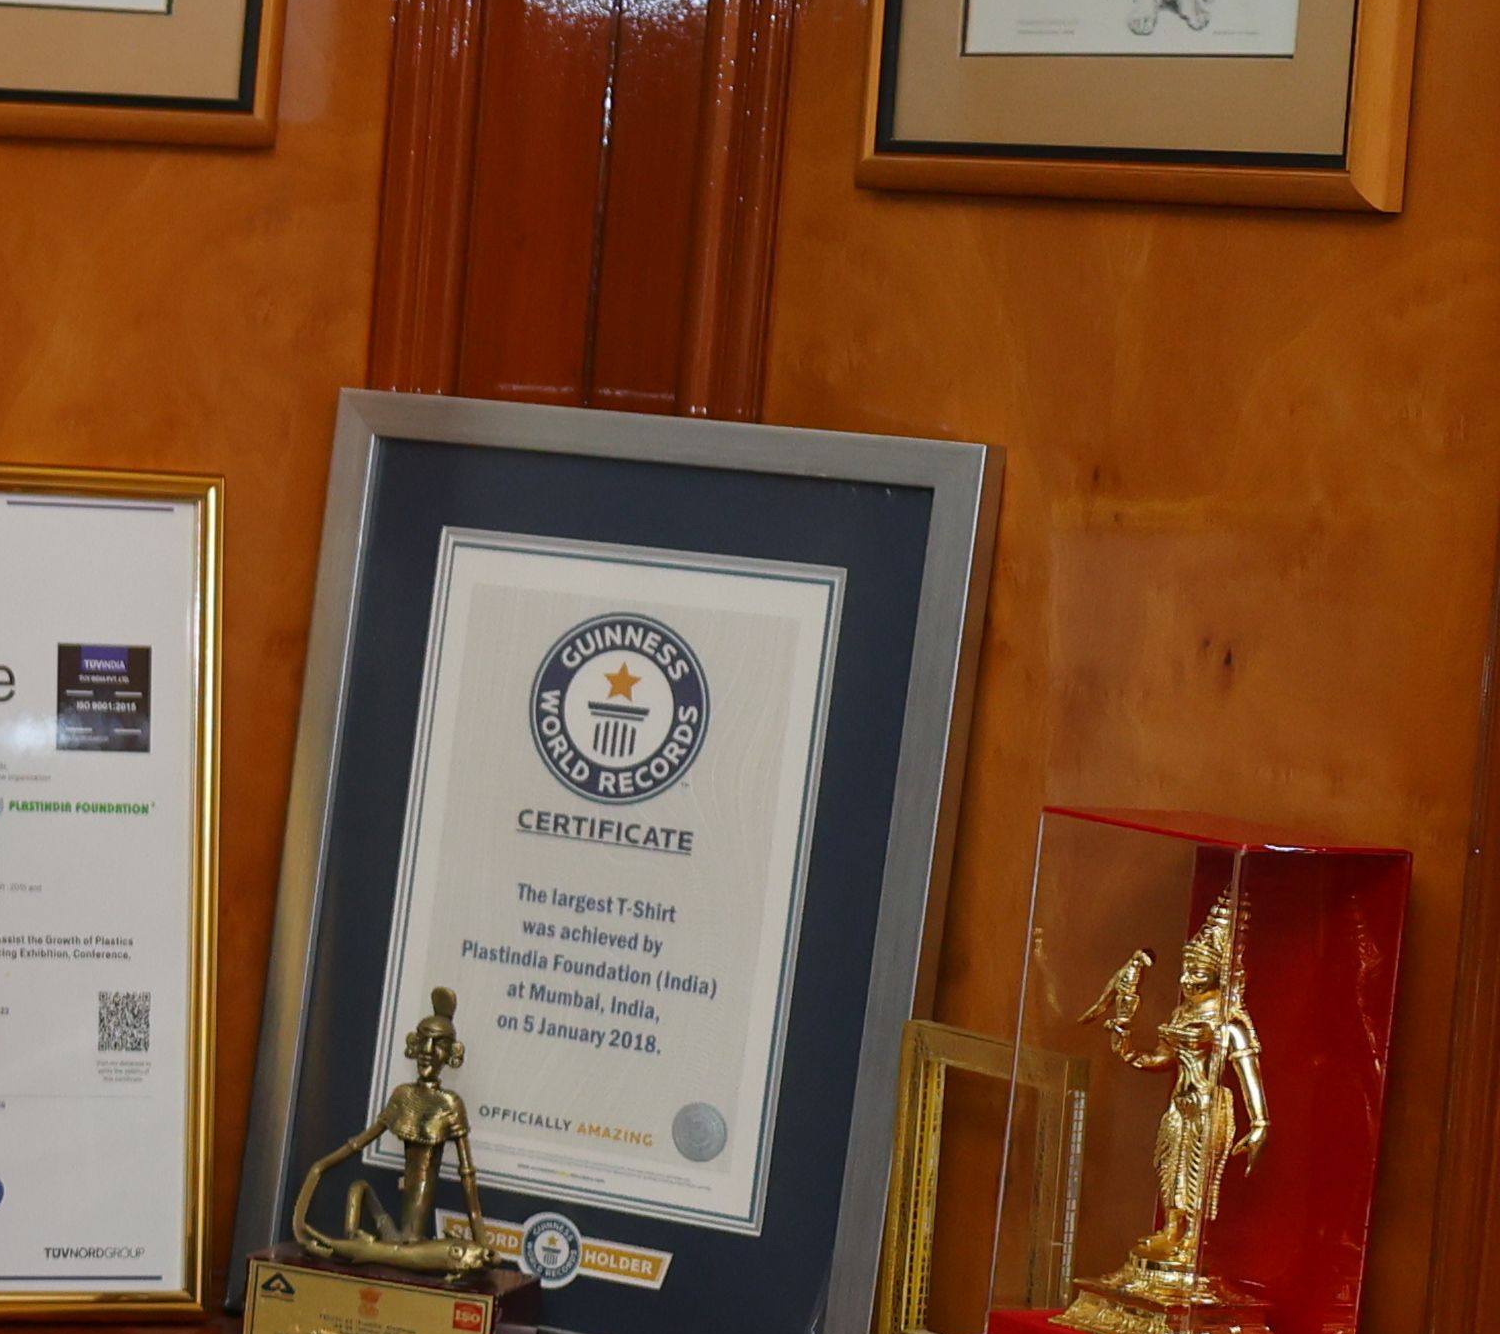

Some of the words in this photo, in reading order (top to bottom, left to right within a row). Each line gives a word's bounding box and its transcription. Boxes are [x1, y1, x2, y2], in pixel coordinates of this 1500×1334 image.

[562, 624, 690, 681] GUINNESS
[541, 689, 590, 782] WORLD
[598, 705, 698, 793] RECORDS
[9, 800, 71, 812] PLASTINDIA
[75, 802, 149, 815] FOUNDATION
[517, 809, 694, 851] CERTIFICATE
[517, 883, 548, 904] The
[552, 888, 613, 914] largest
[617, 898, 677, 923] T-Shirt
[27, 935, 43, 944] the
[45, 935, 81, 945] Growth
[83, 935, 93, 945] of
[95, 936, 134, 946] Plastics
[522, 921, 556, 938] was
[560, 925, 638, 951] achieved
[643, 935, 663, 958] by
[461, 939, 548, 969] Plastindia
[552, 954, 651, 987] Foundation
[656, 970, 717, 1000] (India)
[507, 982, 524, 999] at
[529, 983, 605, 1014] Mumbai,
[611, 996, 660, 1024] India,
[497, 1014, 518, 1030] on
[523, 1015, 534, 1033] 5
[537, 1018, 606, 1047] January
[608, 1029, 661, 1055] 2018.
[479, 1105, 572, 1132] OFFICIALLY
[576, 1122, 653, 1148] AMAZING
[584, 1249, 653, 1275] HOLDER
[455, 1309, 480, 1324] ISO
